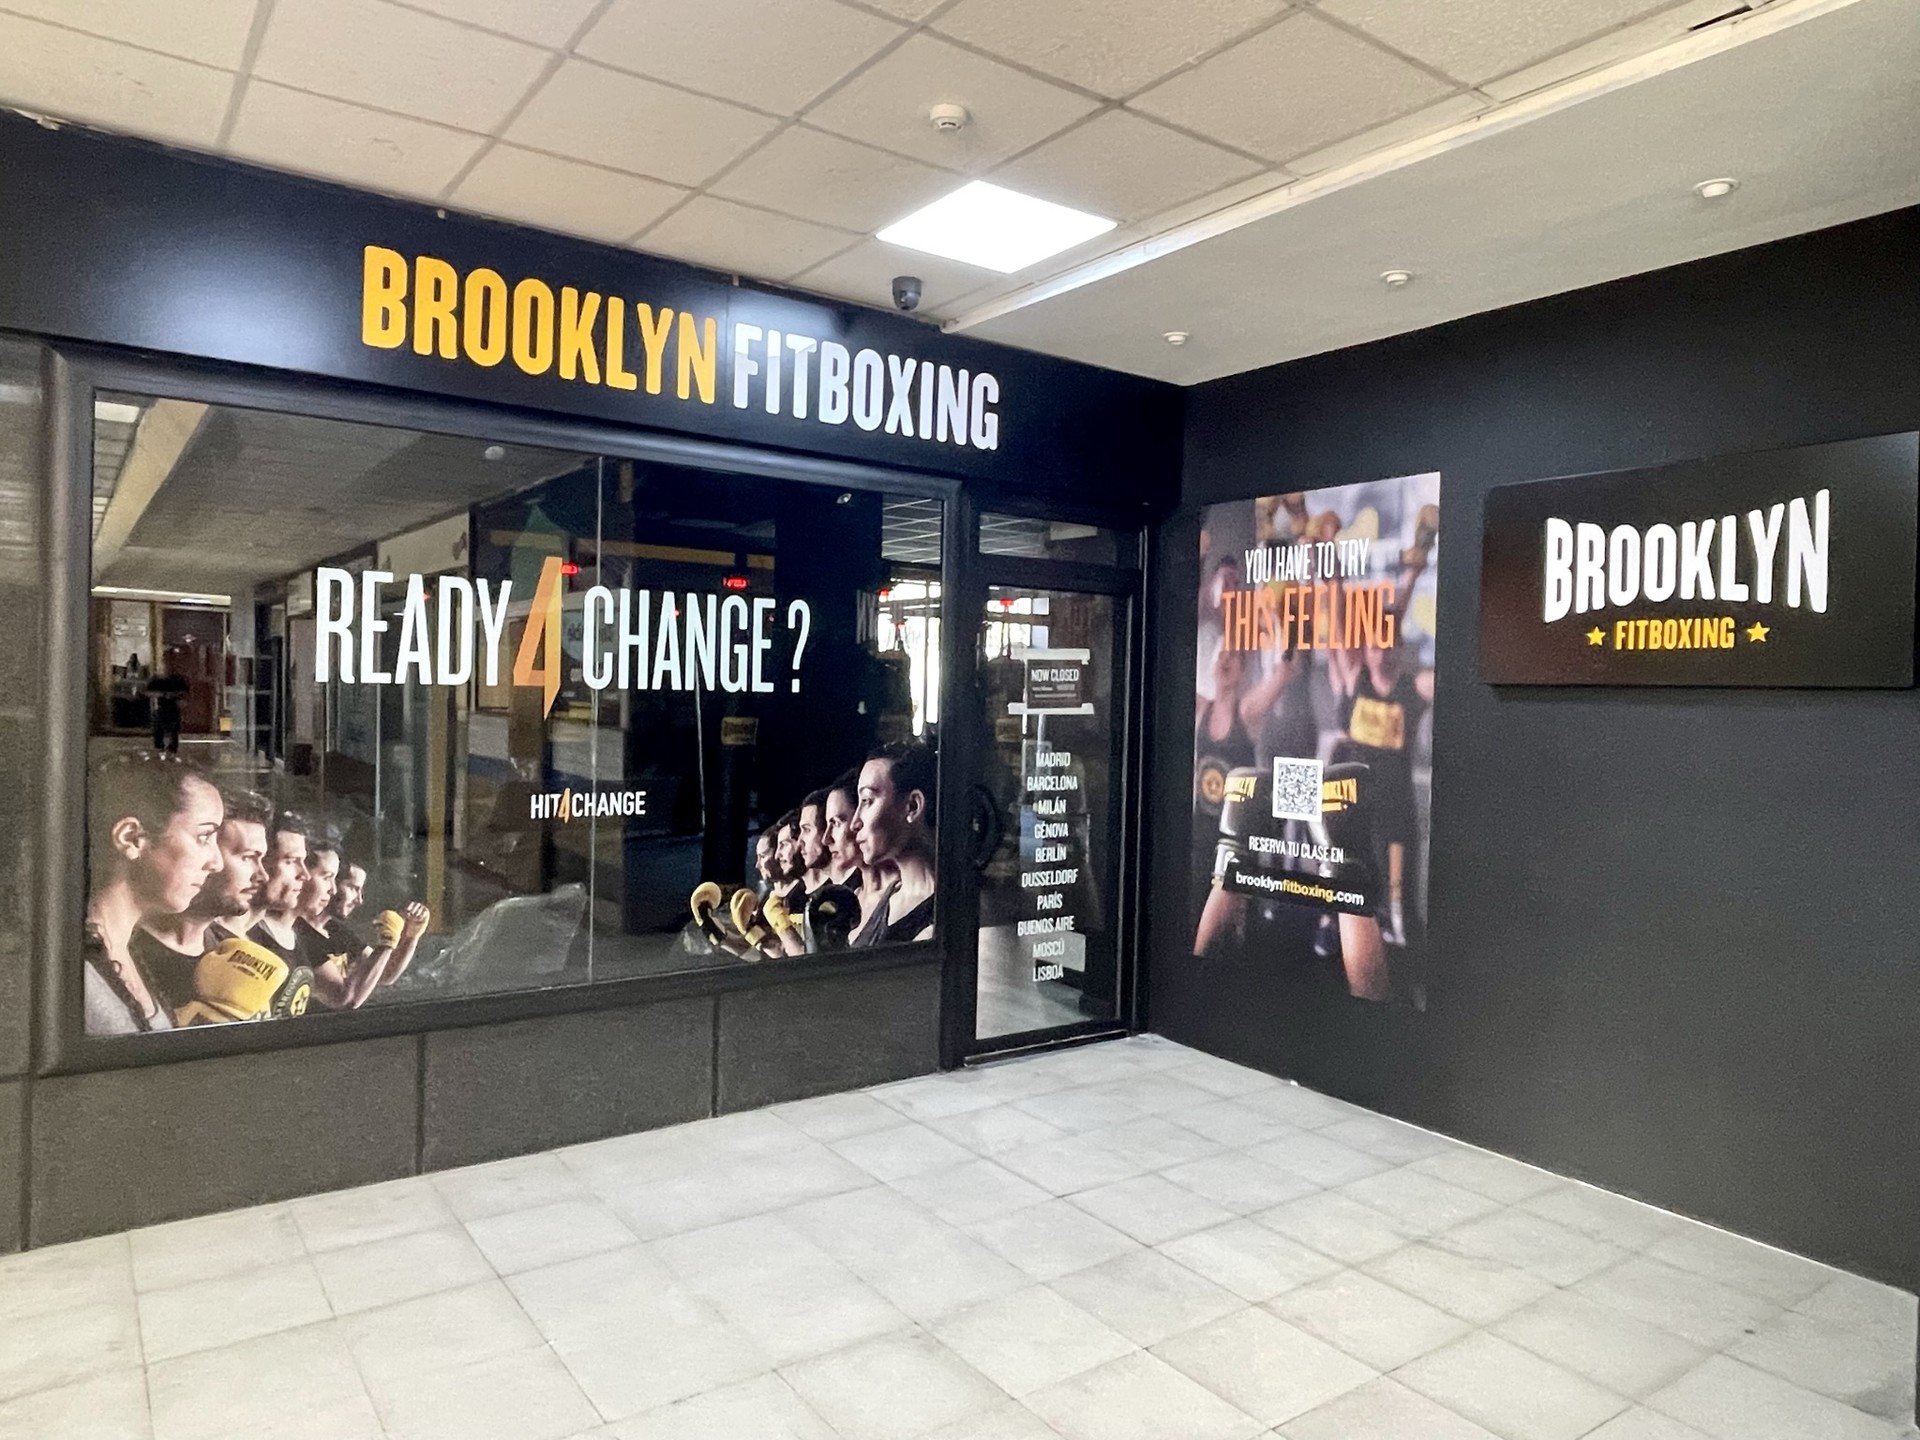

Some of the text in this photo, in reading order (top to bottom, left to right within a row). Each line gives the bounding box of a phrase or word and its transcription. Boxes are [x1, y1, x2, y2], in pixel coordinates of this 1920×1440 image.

[361, 245, 1000, 451] BROOKLYN FITBOXING
[1245, 538, 1369, 584] YOU HAVE TO TRY
[1543, 488, 1831, 624] BROOKLYN
[1221, 580, 1395, 651] THIS FEELING
[314, 566, 513, 687] READY
[582, 586, 777, 693] CHANGE
[1614, 616, 1736, 651] FITBOXING
[1030, 668, 1080, 682] NOW CLOSED
[1036, 752, 1071, 767] MADRID
[1026, 775, 1078, 791] BARCELONA
[1038, 796, 1067, 814] MILÁN
[1034, 821, 1069, 839] GÉNOVA
[1248, 835, 1344, 864] RESERVA TU CLASE EN
[1021, 868, 1079, 888] DUSSELDORF
[1235, 871, 1365, 906] brooklynfitboxing.com
[1017, 915, 1076, 937] BUENOS AIRE
[1032, 964, 1065, 982] LISBOA
